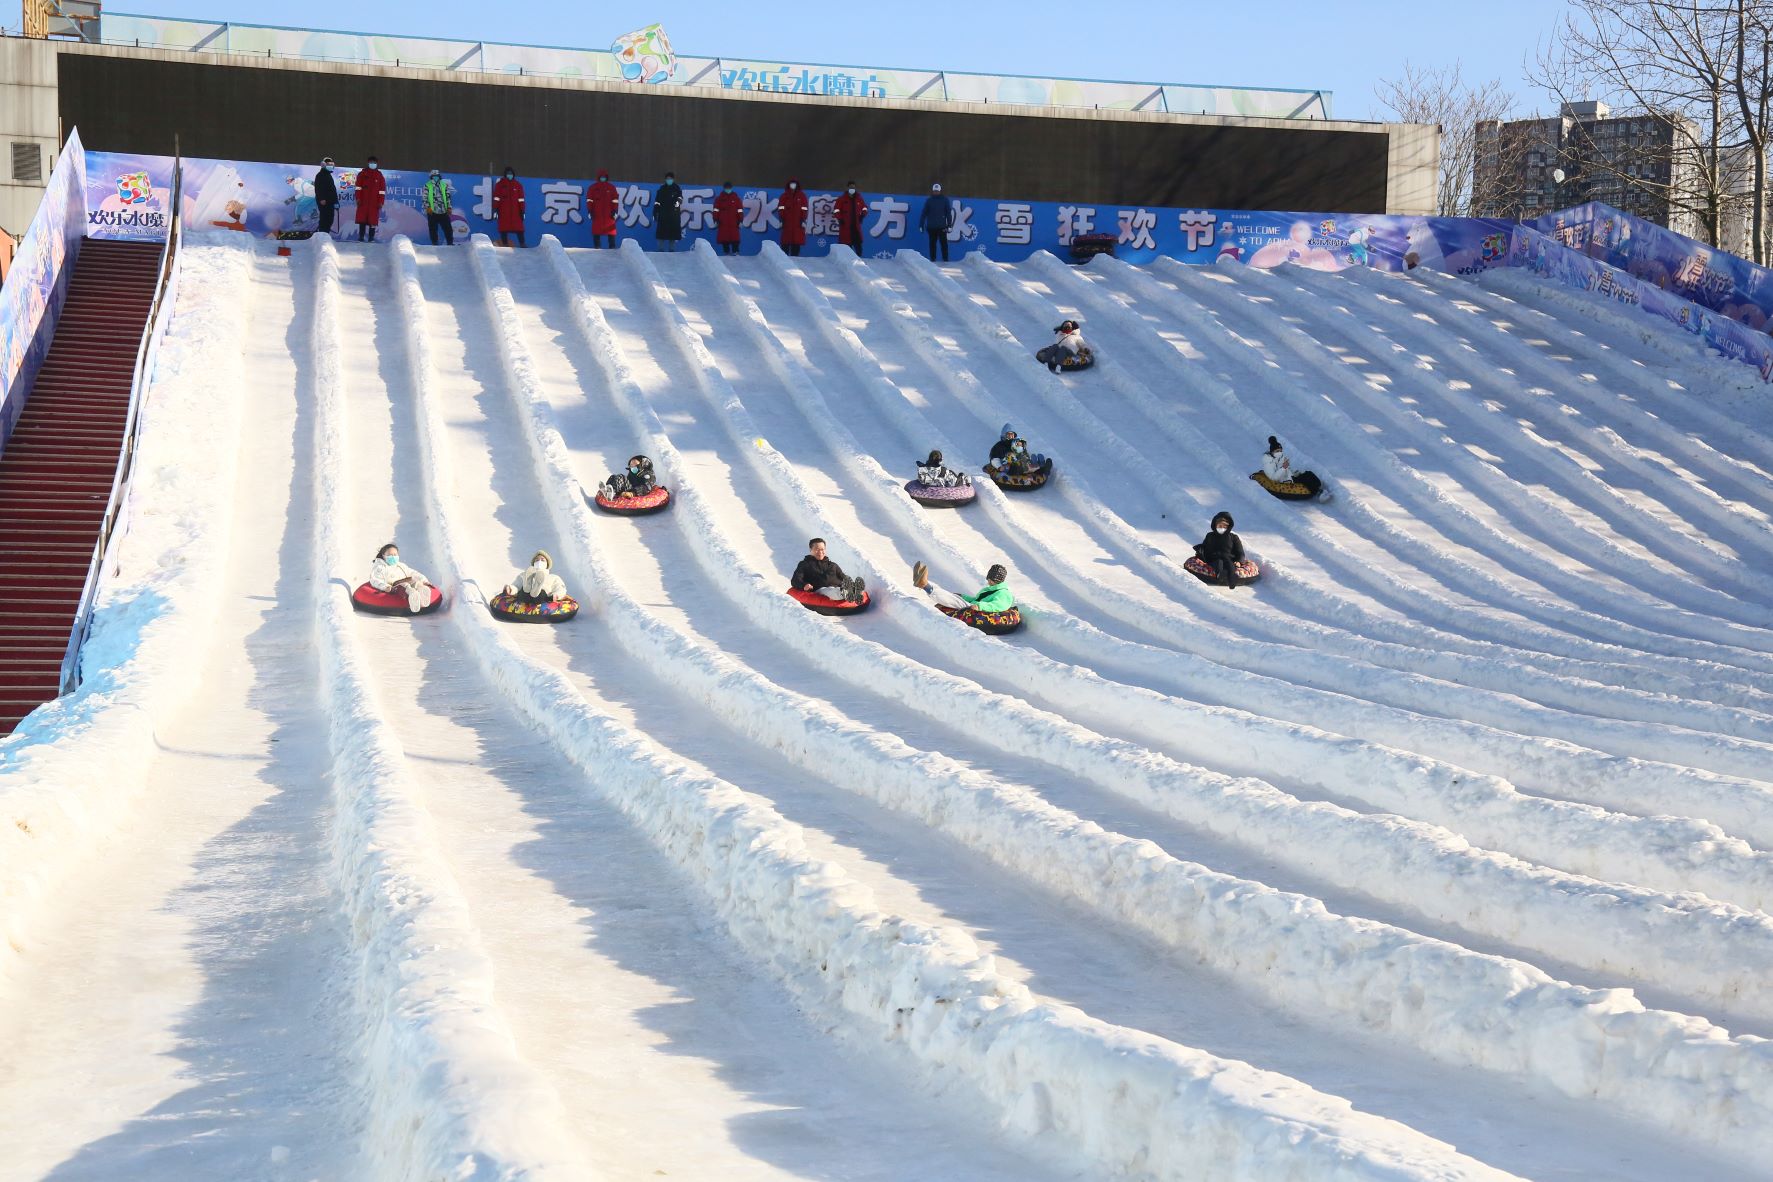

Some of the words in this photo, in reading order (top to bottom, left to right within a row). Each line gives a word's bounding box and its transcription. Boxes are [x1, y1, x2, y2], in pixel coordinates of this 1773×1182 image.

[722, 66, 887, 98] 欢乐水魔方
[88, 208, 168, 228] 欢乐水魔
[1237, 225, 1281, 235] WELCOME
